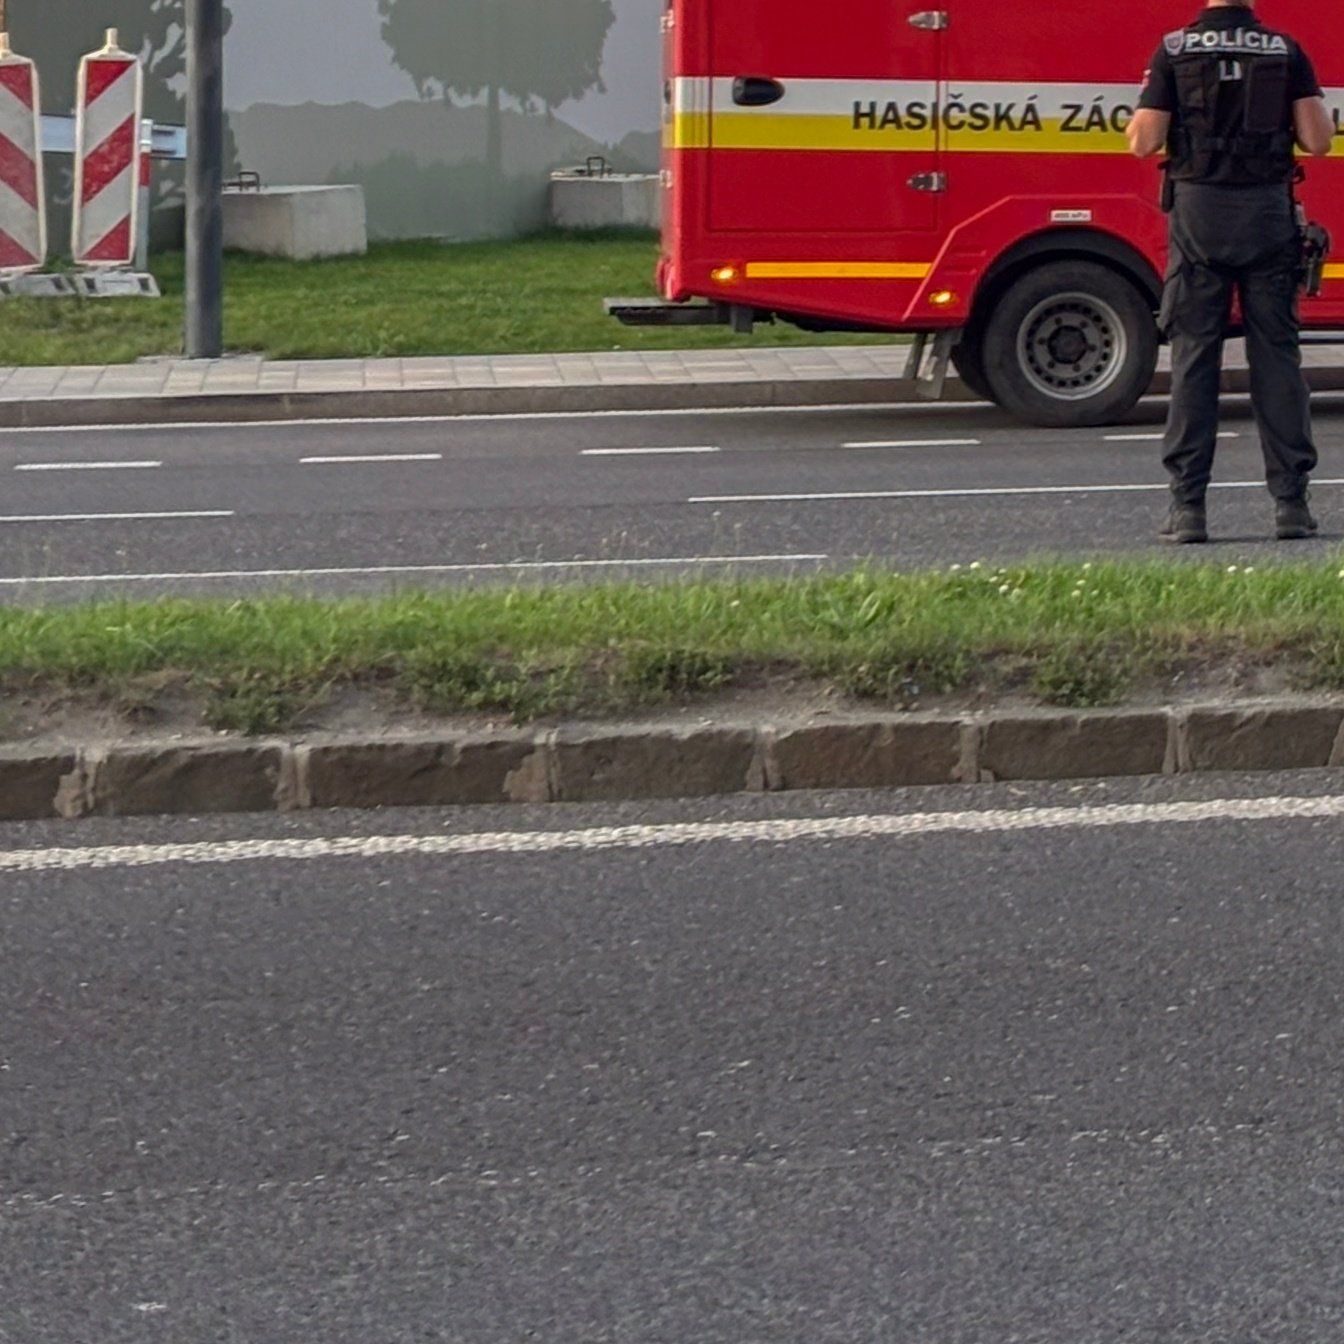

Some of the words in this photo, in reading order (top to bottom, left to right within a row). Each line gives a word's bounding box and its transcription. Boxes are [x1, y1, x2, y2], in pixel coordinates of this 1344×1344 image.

[1185, 27, 1287, 50] POLÍCIA
[852, 93, 1042, 132] HASIČSKÁ
[1059, 94, 1135, 133] ZÁC
